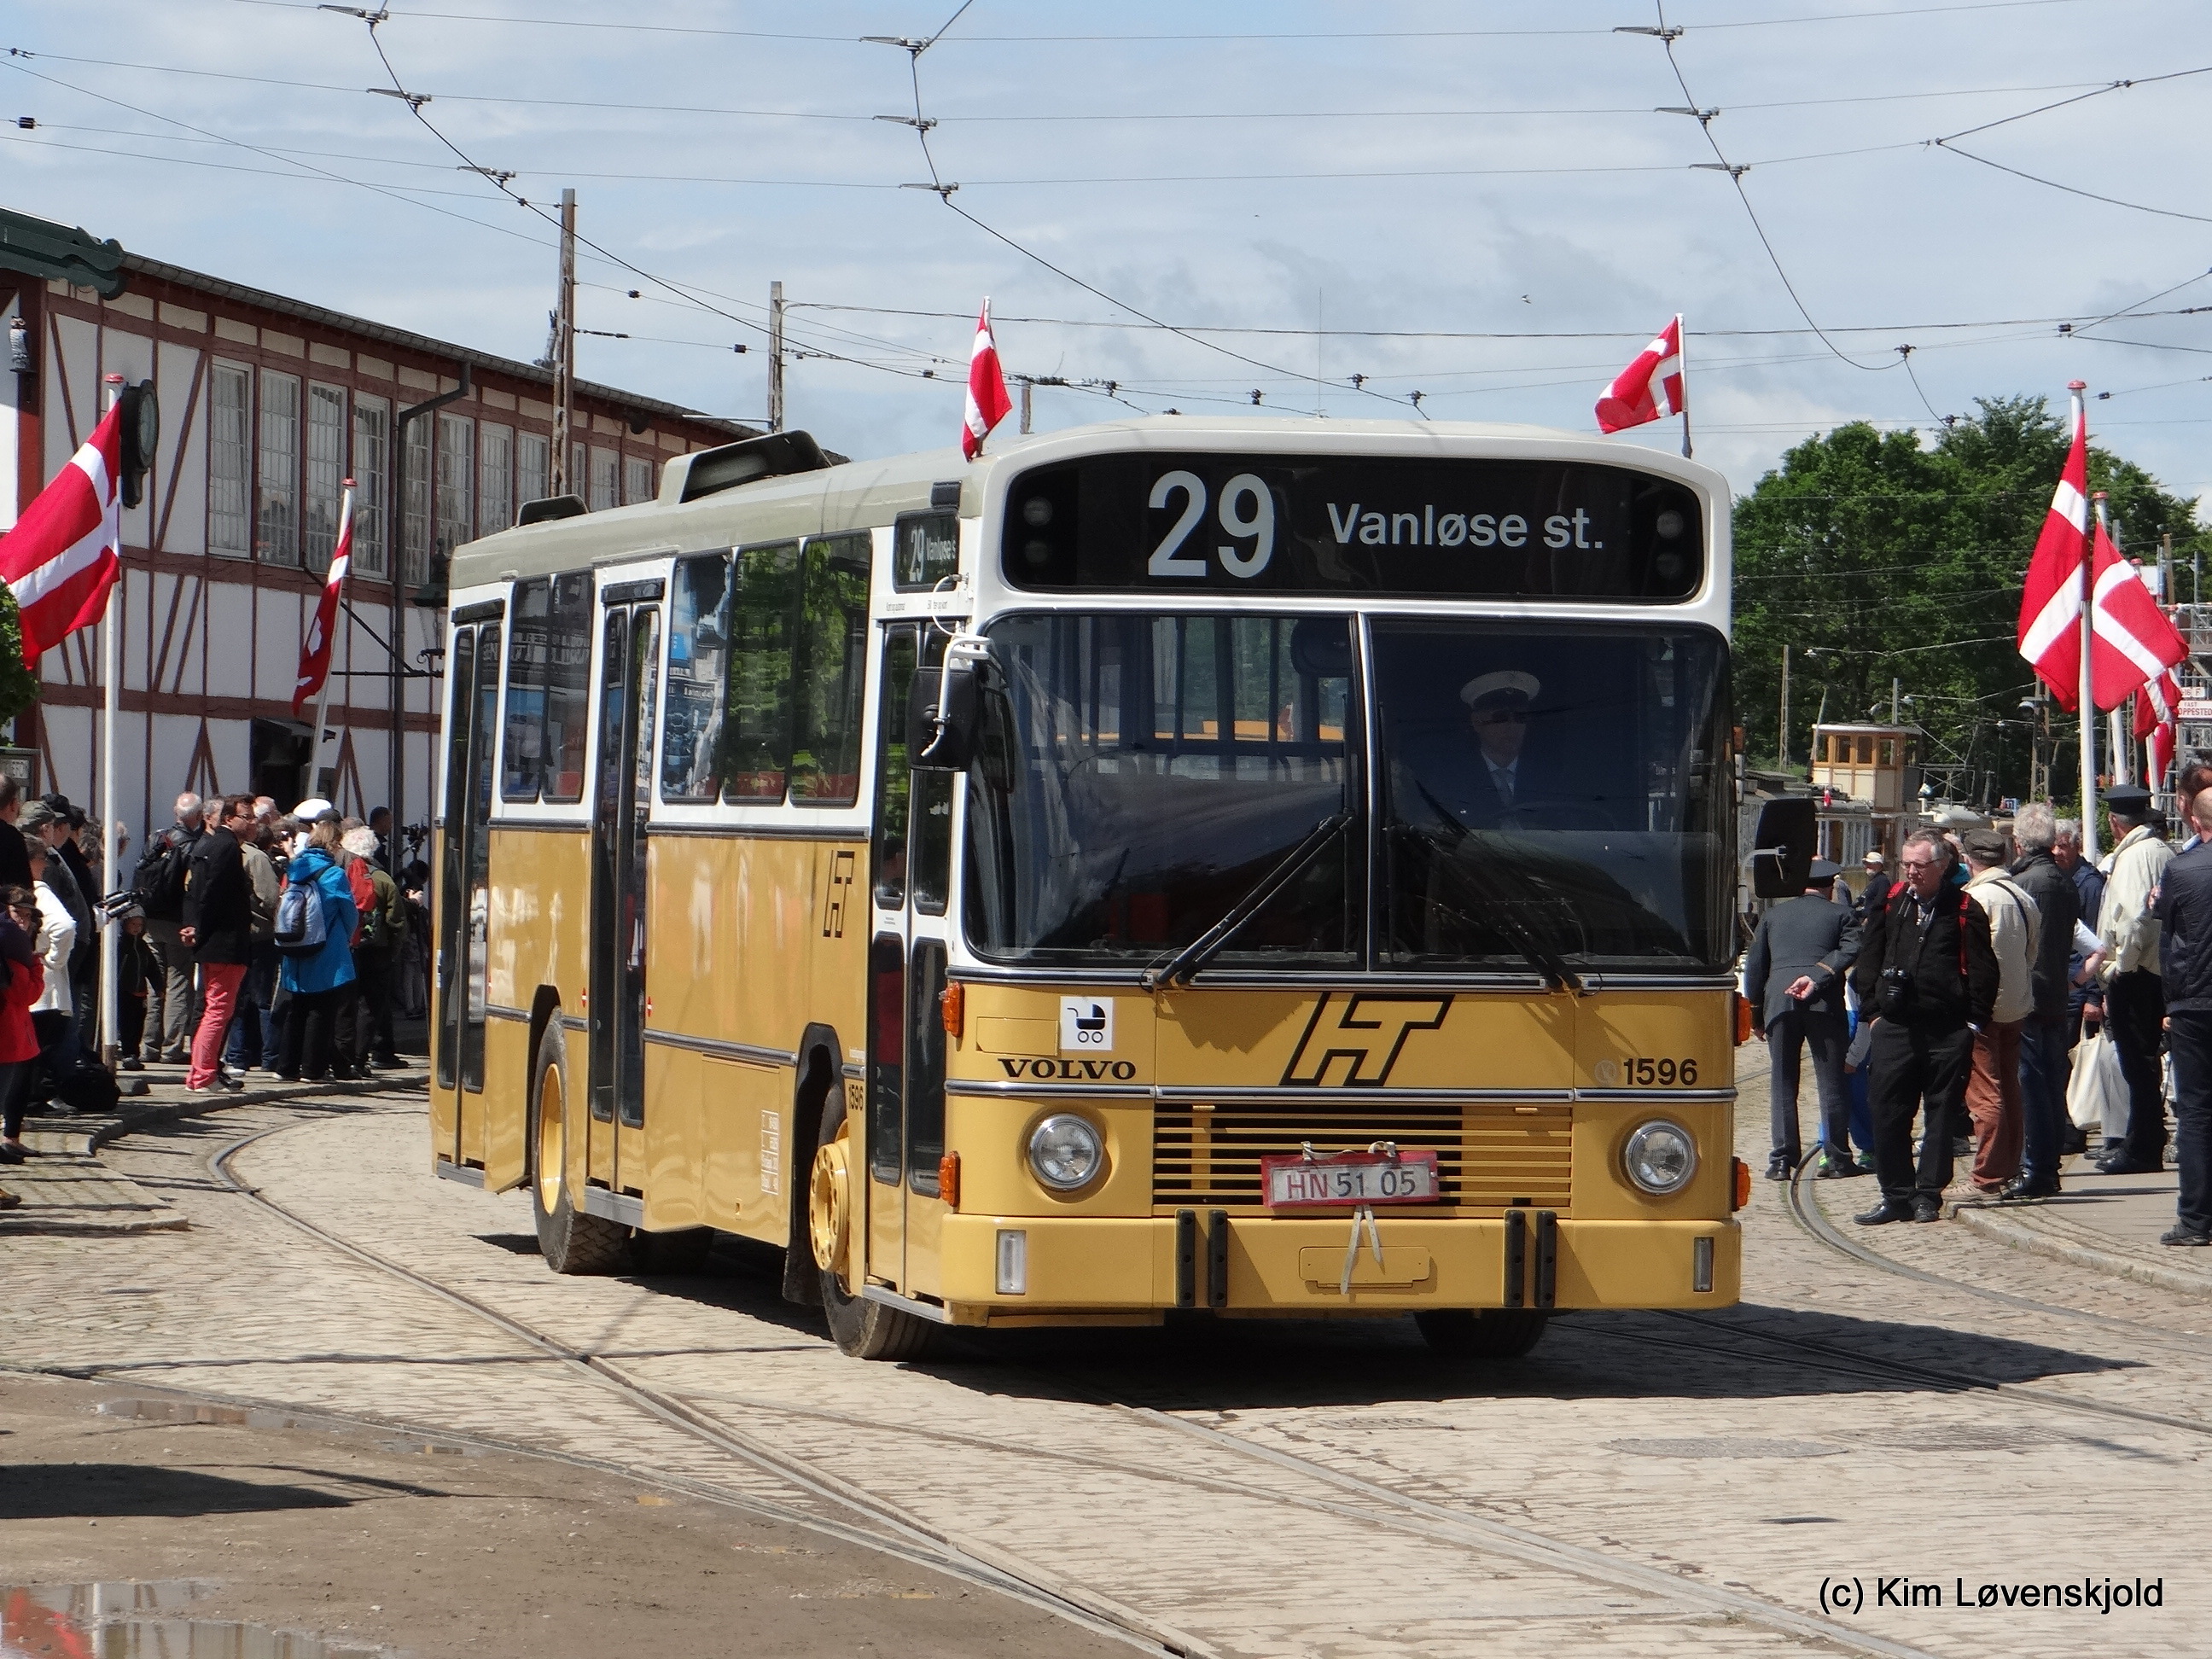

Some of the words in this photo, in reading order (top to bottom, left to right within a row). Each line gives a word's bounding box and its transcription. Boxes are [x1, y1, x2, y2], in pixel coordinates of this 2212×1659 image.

[1148, 470, 1275, 579] 29
[1327, 503, 1528, 547] Vanløse
[1543, 508, 1603, 549] st.
[909, 524, 925, 582] 29
[2179, 707, 2212, 716] OPPESTED
[997, 1057, 1137, 1080] VOLVO
[1623, 1057, 1697, 1086] 1596
[848, 1084, 864, 1111] 1596
[1286, 1172, 1328, 1199] HN
[1336, 1172, 1365, 1197] 51
[1380, 1170, 1417, 1196] 05
